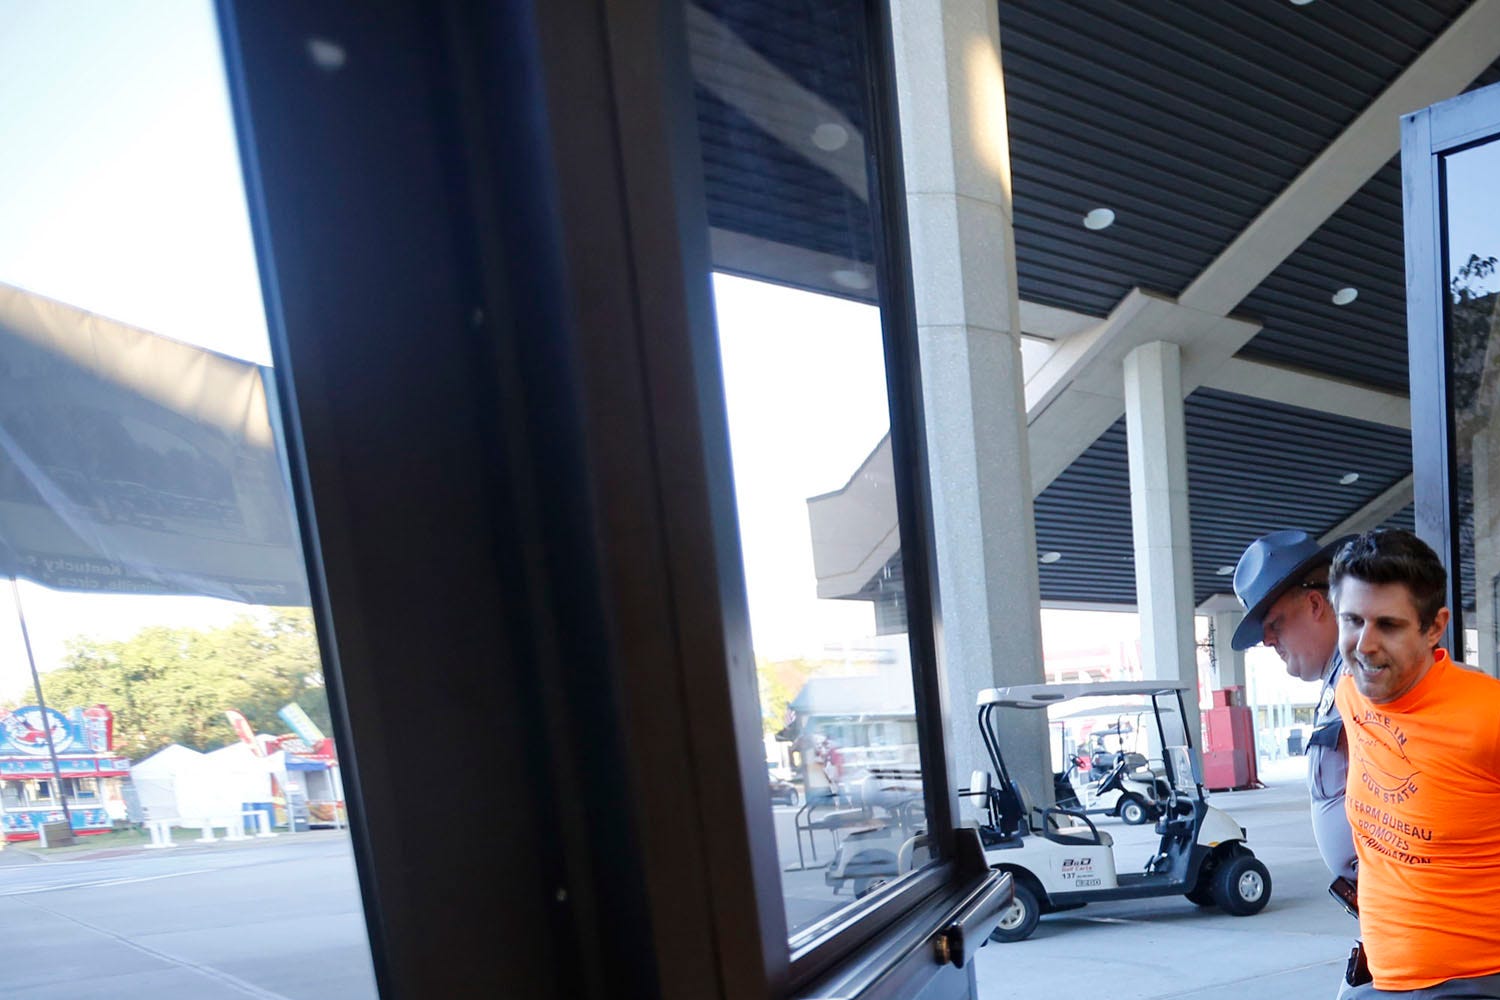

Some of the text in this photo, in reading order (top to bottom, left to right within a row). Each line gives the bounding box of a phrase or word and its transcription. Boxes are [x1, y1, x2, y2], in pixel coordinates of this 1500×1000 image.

[1364, 710, 1392, 728] HATE
[1394, 726, 1408, 746] IN
[1361, 772, 1418, 804] OUR STATE
[1355, 799, 1382, 822] FARM
[1381, 812, 1432, 841] BUREAU
[1359, 819, 1410, 851] PROMOTES
